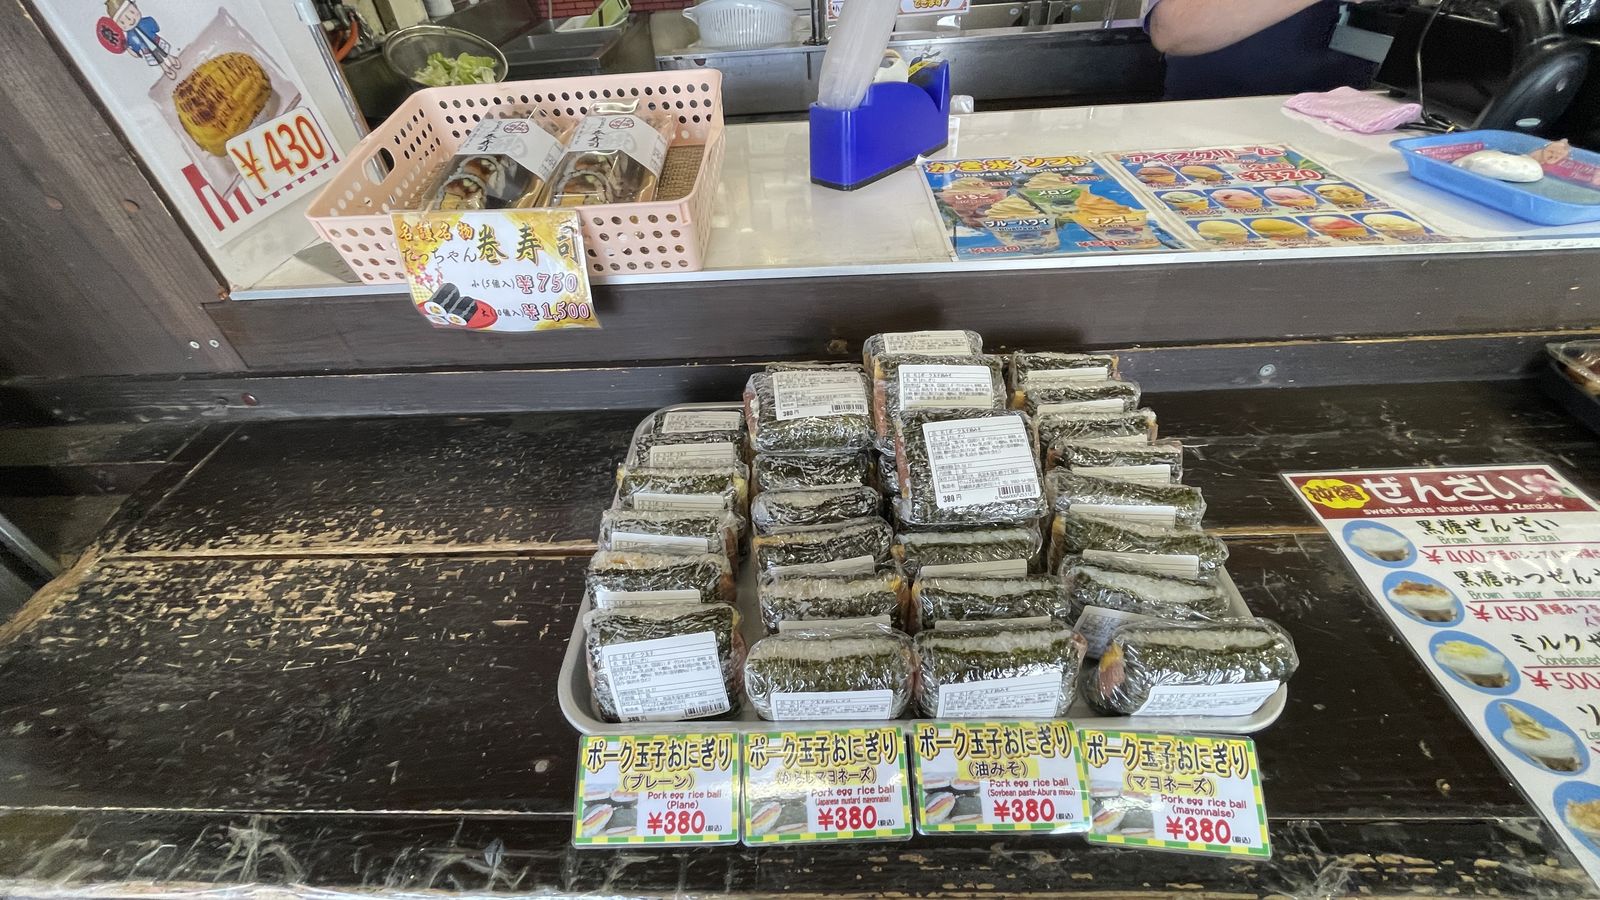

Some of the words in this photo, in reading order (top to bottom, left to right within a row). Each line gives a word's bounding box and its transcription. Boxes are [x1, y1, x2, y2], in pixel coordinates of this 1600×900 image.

[230, 115, 326, 191] ¥430
[399, 220, 475, 242] 名護名物
[477, 221, 580, 266] 巻寿司
[515, 273, 578, 295] ¥750
[522, 301, 591, 323] ¥1,500
[1362, 474, 1532, 505] ぜんざい
[1363, 506, 1399, 516] sweet
[1400, 505, 1434, 515] beans
[1436, 504, 1479, 513] shaved
[1480, 503, 1500, 512] ice
[1416, 516, 1560, 536] 黒糖ぜんざい
[1437, 535, 1473, 545] Brown
[1481, 535, 1512, 545] sugar
[1419, 549, 1487, 565] ¥400
[1453, 568, 1600, 589] 黒糖みつぜん
[1467, 590, 1504, 600] Brown
[1512, 591, 1543, 600] sugar
[1466, 604, 1540, 623] ¥450
[750, 731, 897, 768] ポーク玉子おにぎり
[918, 725, 1071, 759] ポーク玉子おにぎり
[586, 736, 733, 770] ポーク玉子おにぎり
[1086, 734, 1250, 778] ポーク玉子おにぎり
[968, 760, 1028, 778] (油みそ)
[623, 773, 695, 791] (プレーン)
[811, 788, 834, 797] Pork
[836, 788, 853, 797] egg
[857, 785, 875, 795] rice
[878, 784, 895, 794] ball
[989, 779, 1011, 788] Pork
[1013, 780, 1029, 788] egg
[1033, 779, 1051, 787] rice
[1052, 778, 1069, 787] ball
[1126, 773, 1215, 797] (マヨネーズ)
[647, 791, 668, 800] Pork
[669, 792, 685, 800] egg
[688, 791, 704, 799] rice
[706, 789, 722, 799] ball
[666, 800, 699, 810] (Plane)
[1160, 794, 1184, 804] Pork
[1186, 798, 1203, 807] egg
[1207, 798, 1227, 807] rice
[1229, 799, 1247, 809] ball
[817, 805, 878, 831] ¥380
[993, 798, 1055, 823] ¥380
[1172, 805, 1235, 819] (mayonnaise)
[647, 810, 706, 835] ¥380
[1166, 816, 1232, 844] ¥380
